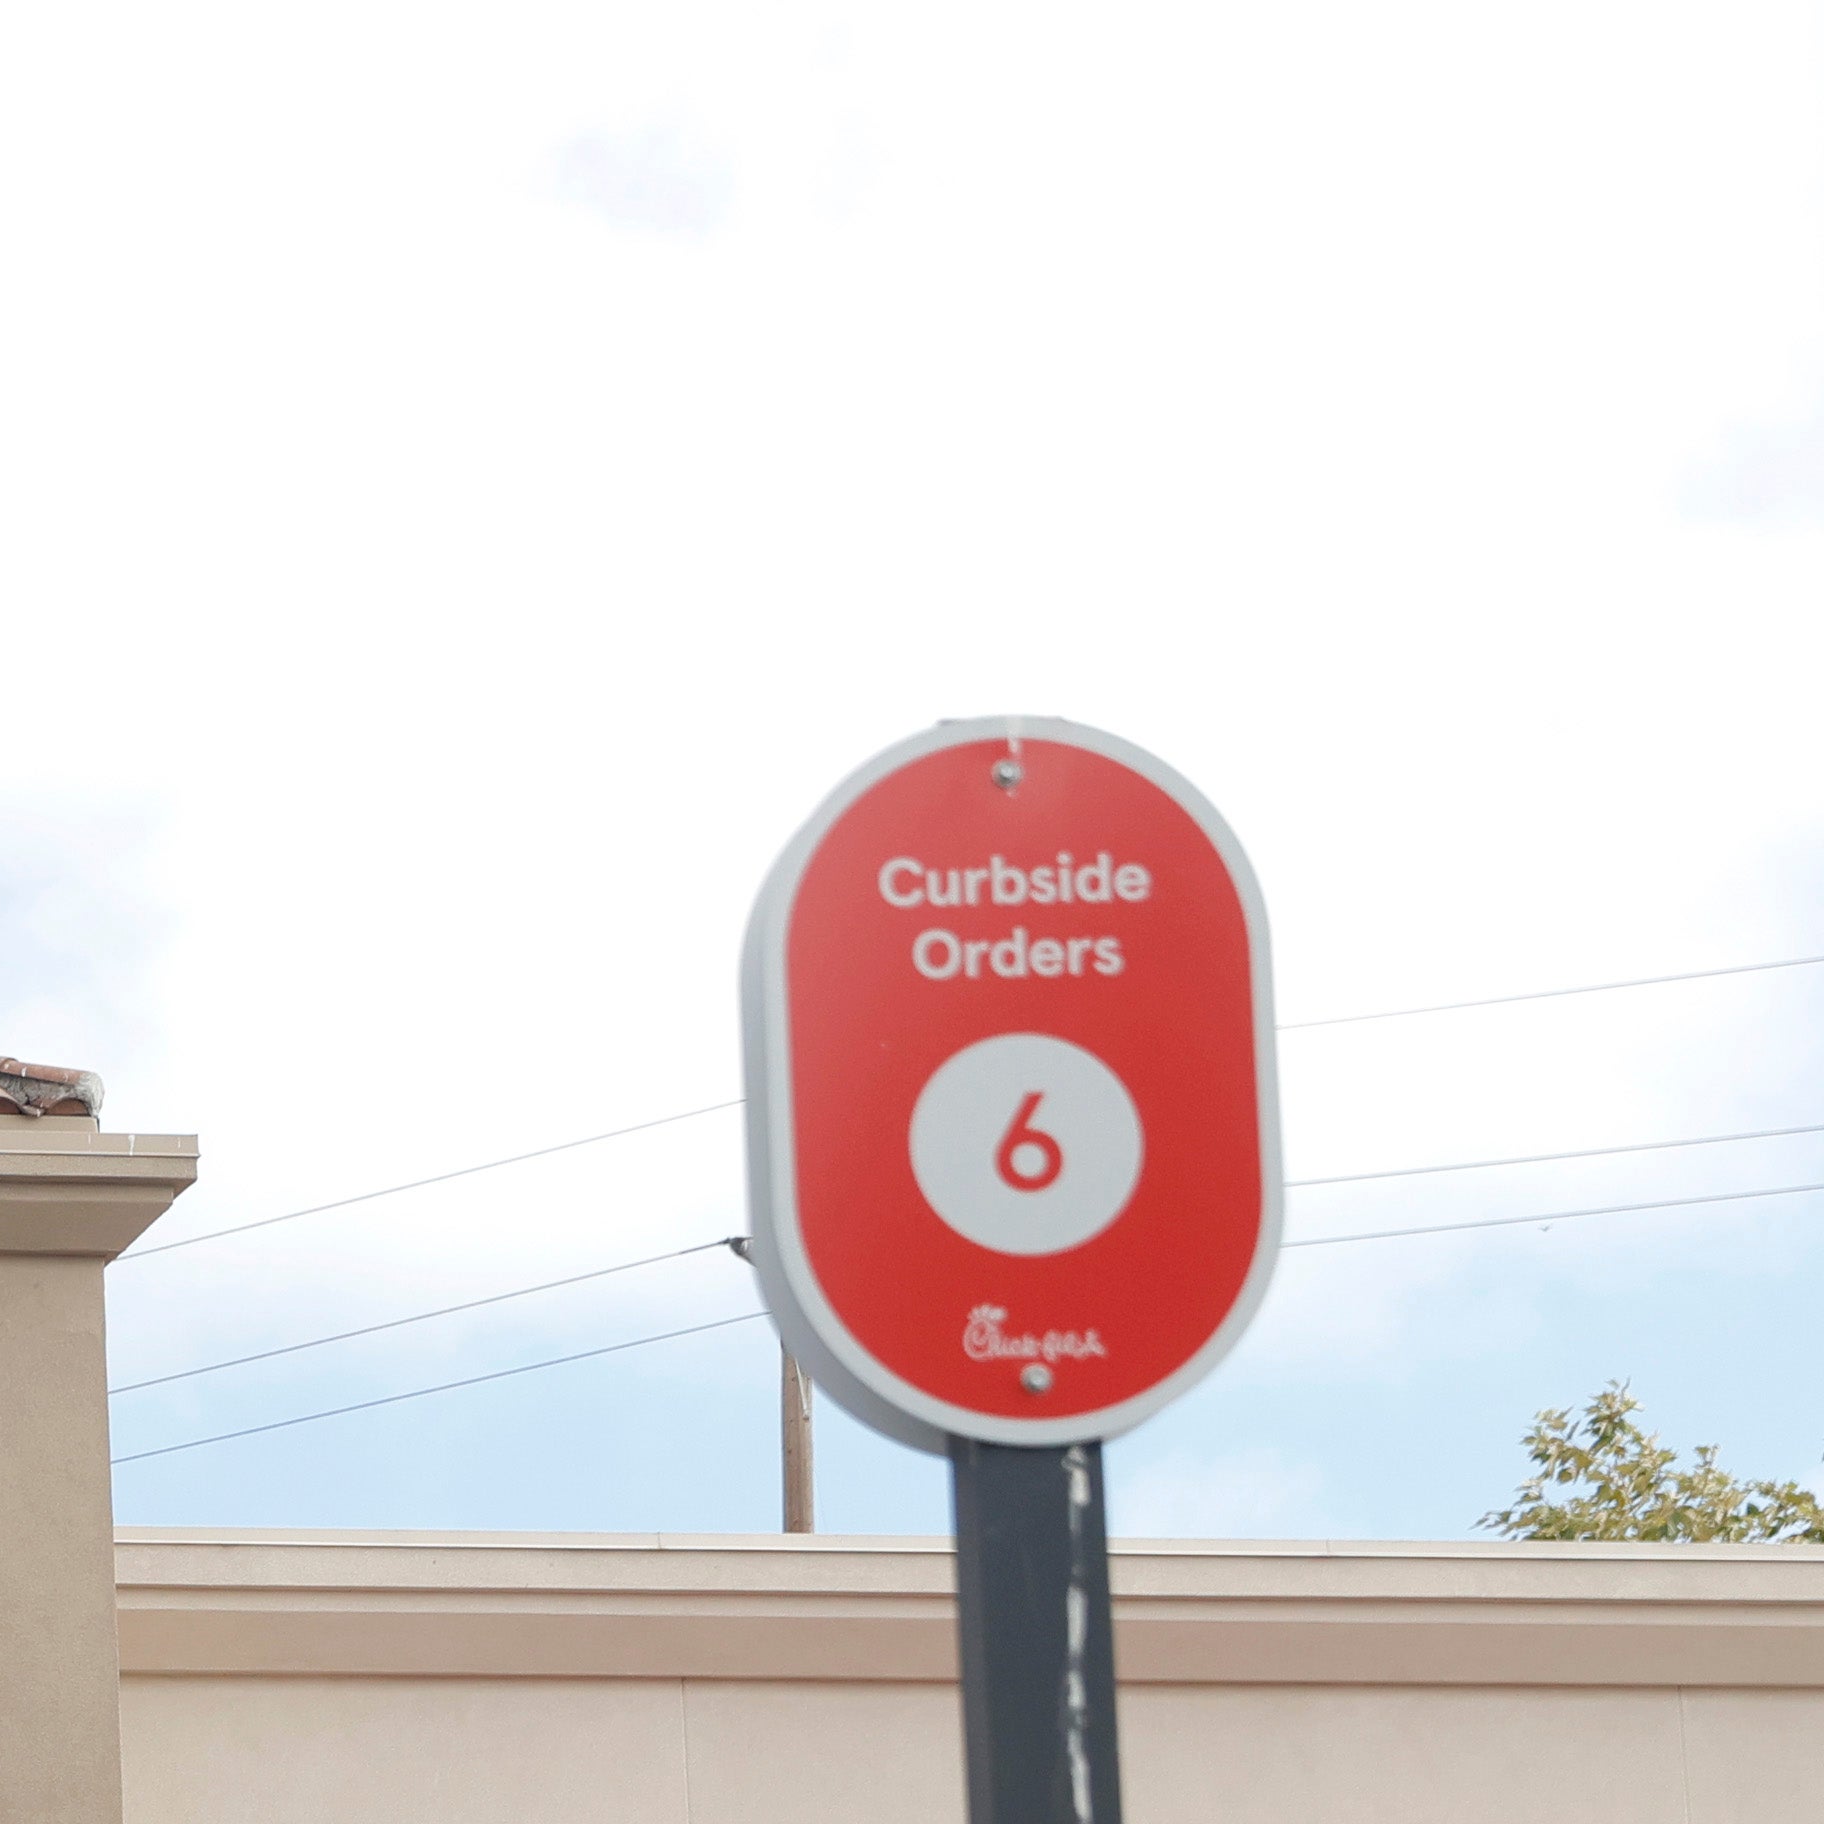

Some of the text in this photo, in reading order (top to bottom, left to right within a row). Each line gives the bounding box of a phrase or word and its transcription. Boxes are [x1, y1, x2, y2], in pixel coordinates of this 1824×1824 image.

[878, 852, 1152, 906] Curbside
[911, 928, 1127, 981] Orders
[994, 1090, 1066, 1194] 6
